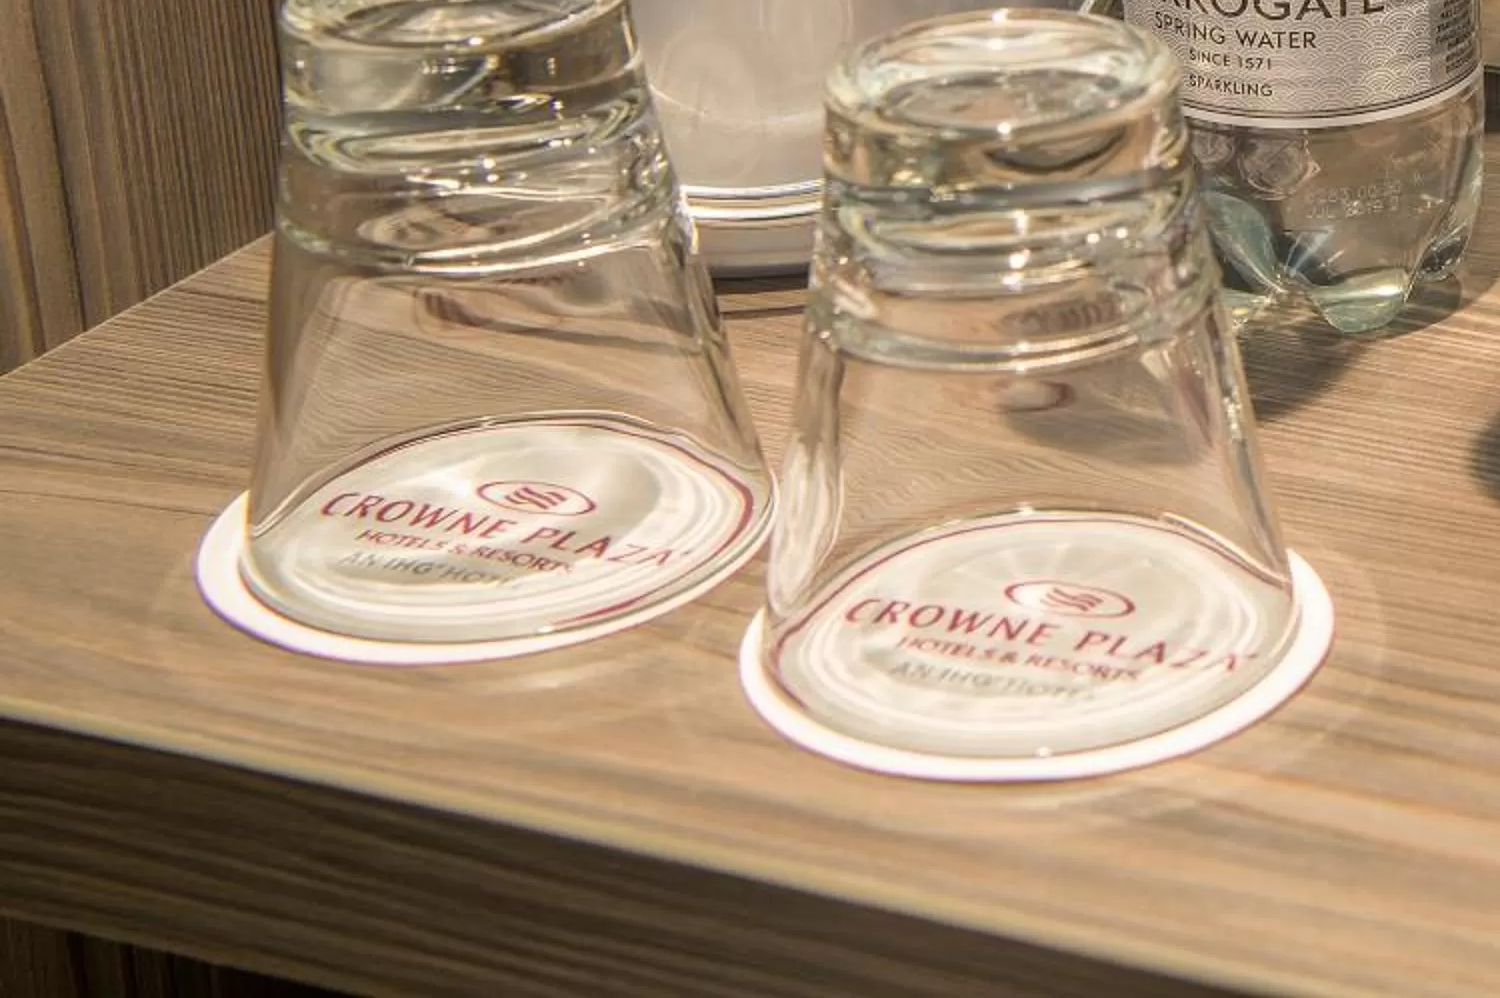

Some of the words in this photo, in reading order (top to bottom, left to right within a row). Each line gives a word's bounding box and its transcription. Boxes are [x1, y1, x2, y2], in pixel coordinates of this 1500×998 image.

[1154, 10, 1226, 44] SPRING
[1235, 30, 1317, 50] WATER
[1189, 49, 1231, 68] SINCE
[1237, 56, 1272, 71] 1571
[1189, 73, 1273, 97] SPARKLING
[319, 491, 518, 540] CROWNE
[520, 525, 673, 568] PLAZA
[843, 598, 1061, 650] CROWNE
[1073, 630, 1241, 672] PLAZA
